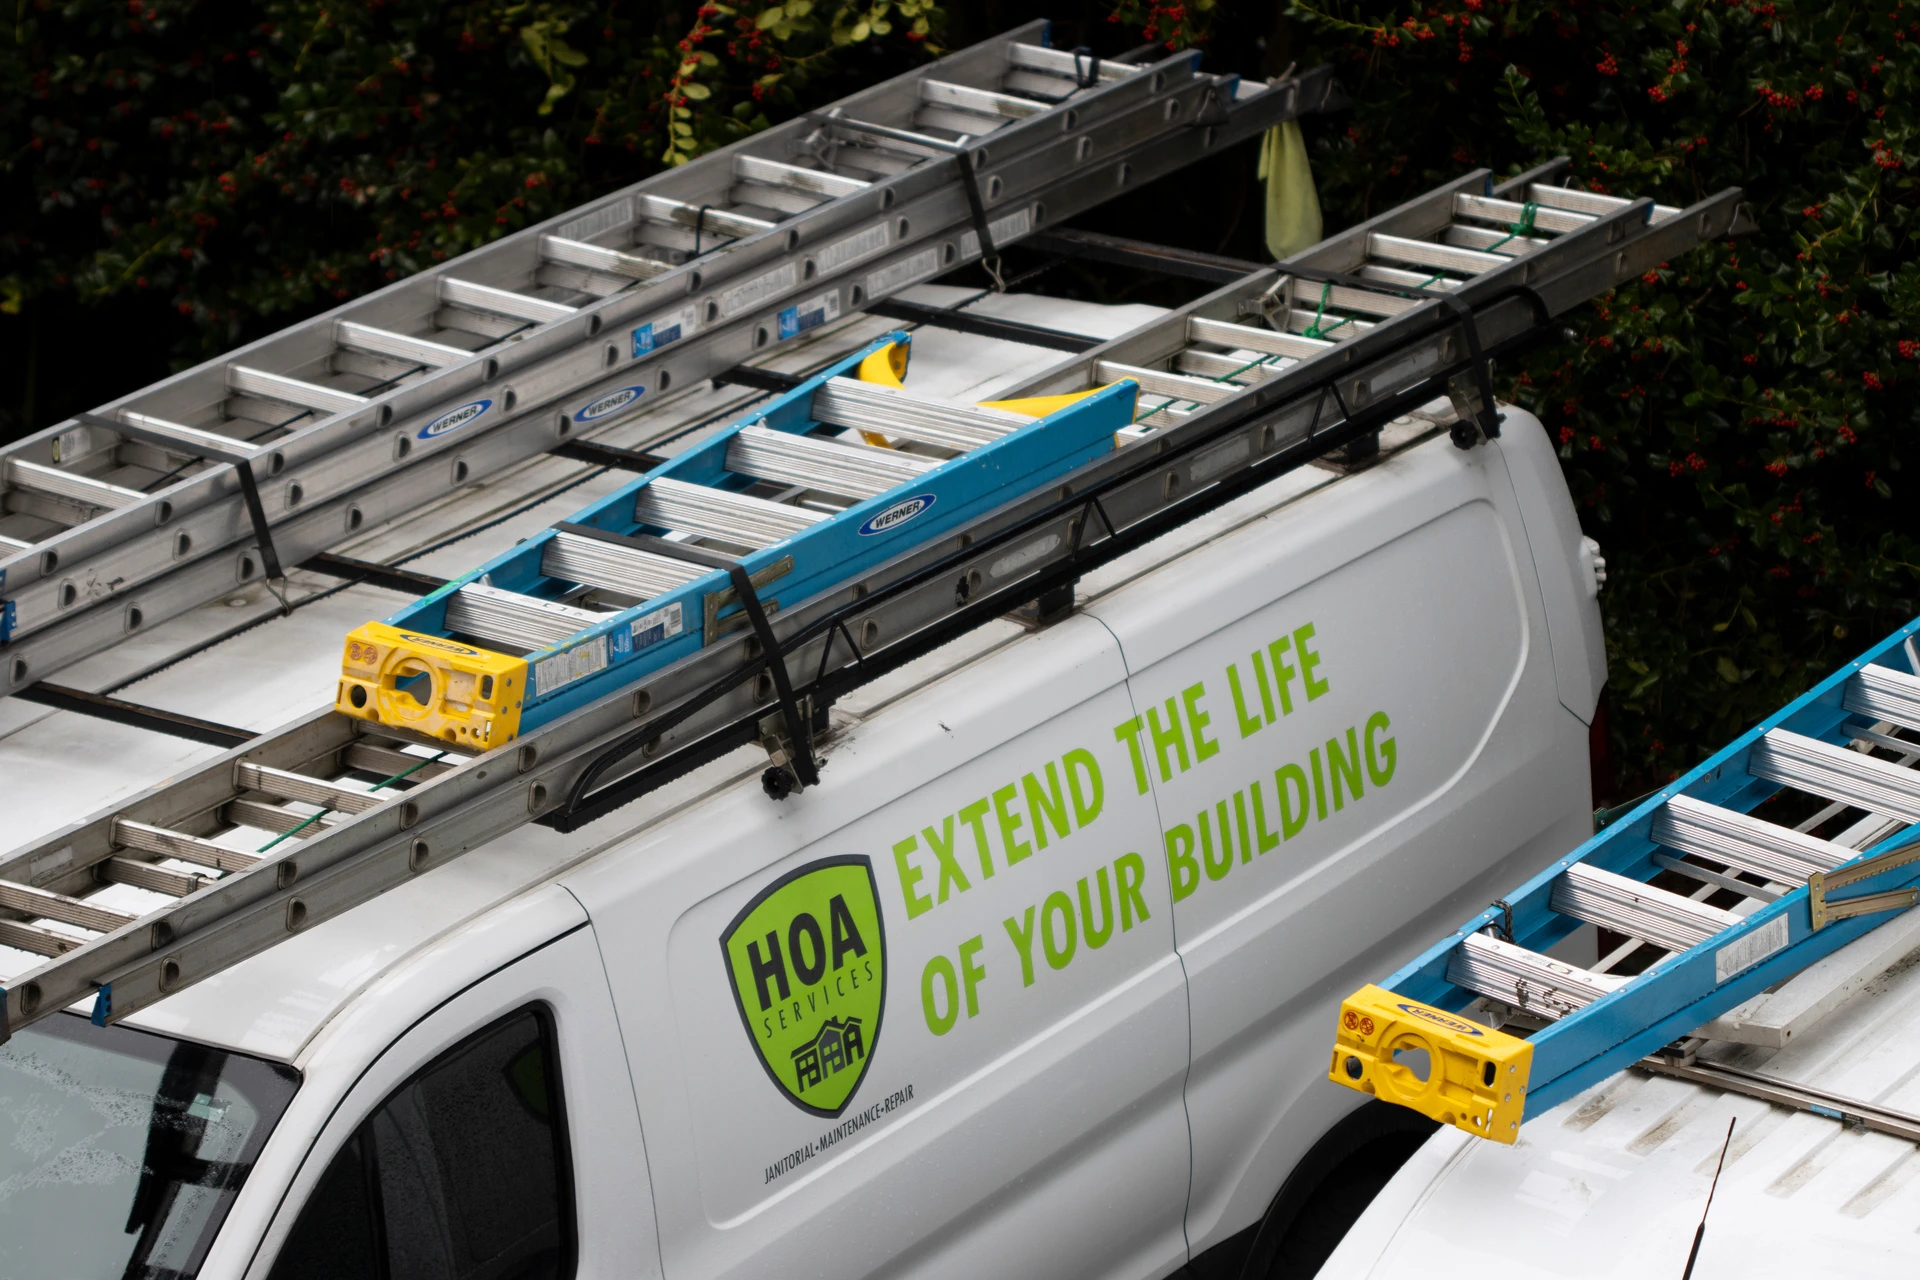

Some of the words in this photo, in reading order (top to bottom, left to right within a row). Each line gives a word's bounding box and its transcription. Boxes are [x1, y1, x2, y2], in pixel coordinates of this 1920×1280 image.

[432, 405, 479, 433] WERNER
[588, 391, 632, 417] WERNER
[876, 500, 920, 528] WERNER
[892, 748, 1104, 920] EXTEND
[1114, 681, 1220, 795] THE
[1226, 622, 1329, 739] LIFE
[920, 934, 985, 1036] OF
[1003, 852, 1150, 987] YOUR
[1164, 711, 1397, 903] BUILDING
[746, 893, 868, 1012] HOA
[764, 961, 873, 1038] SERVICES
[1412, 1009, 1467, 1031] WERNER
[764, 1142, 816, 1184] JANITORIAL
[819, 1103, 881, 1152] MAINTENANCE
[884, 1084, 914, 1114] REPAIR
